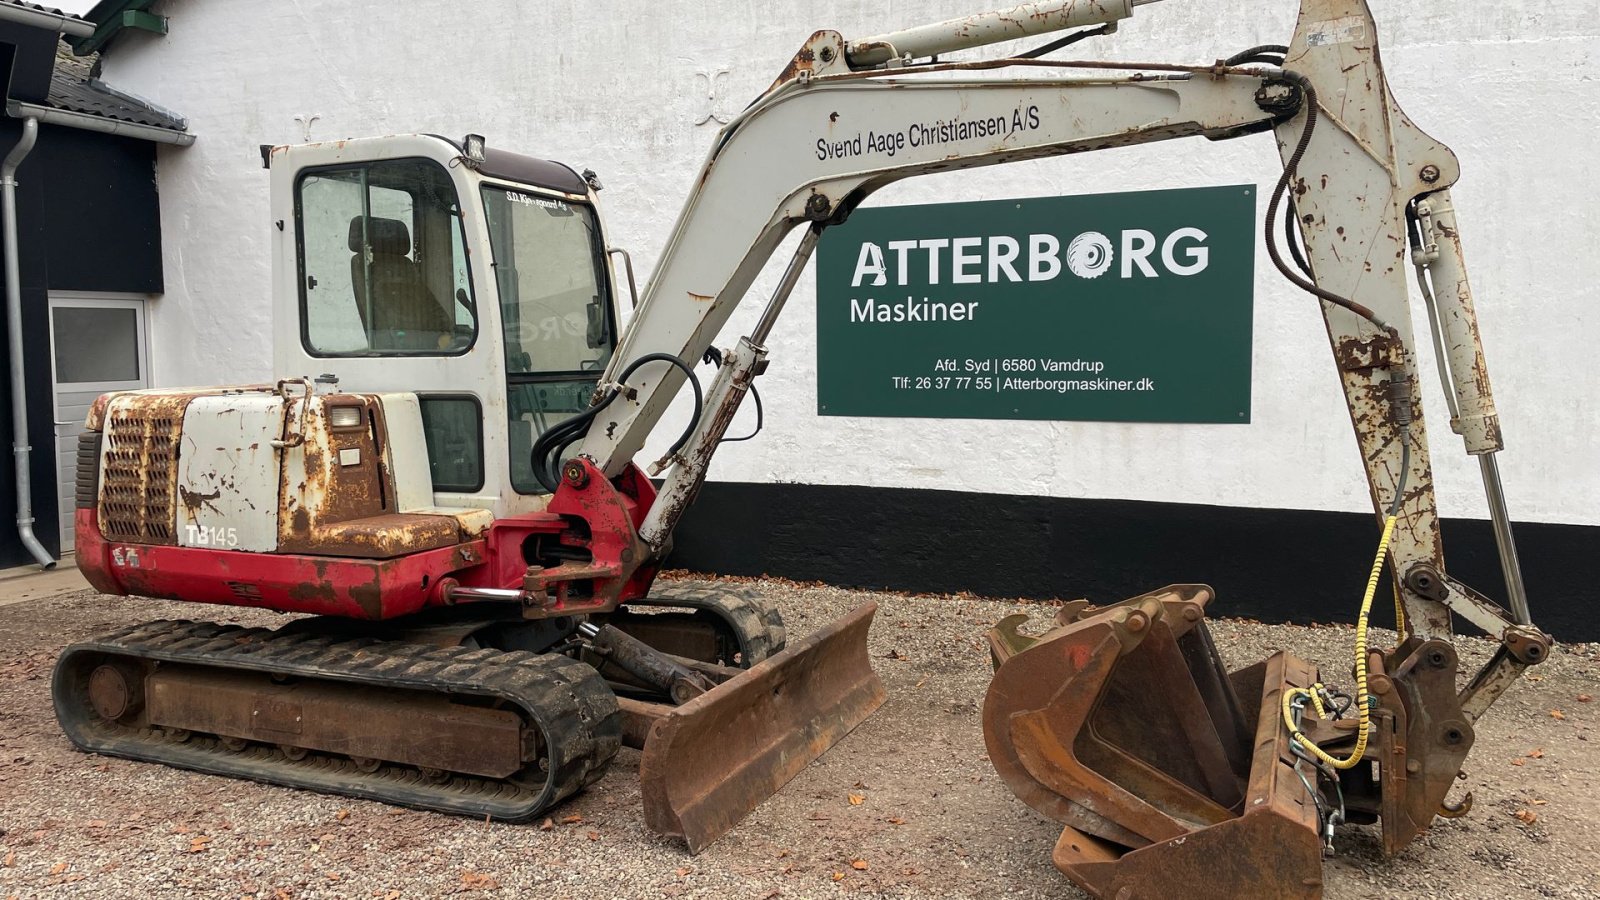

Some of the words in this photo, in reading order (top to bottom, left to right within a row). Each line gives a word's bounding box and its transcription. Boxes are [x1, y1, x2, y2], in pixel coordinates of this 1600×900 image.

[816, 133, 862, 161] Svend
[867, 132, 905, 156] Aage
[909, 117, 1006, 148] Christiansen
[1009, 106, 1040, 132] A/S
[850, 227, 1209, 287] ATTERBORG
[850, 296, 979, 323] Maskiner
[934, 358, 961, 372] Afd.
[964, 358, 990, 375] Syd
[1002, 358, 1037, 372] 6580
[1041, 358, 1105, 375] Vamdrup
[892, 376, 912, 390] Tlf:
[915, 376, 932, 390] 26
[935, 376, 952, 390] 37
[955, 376, 972, 390] 77
[975, 376, 993, 390] 55
[1003, 377, 1155, 394] Atterborgmaskiner.dk
[185, 524, 238, 547] TB145
